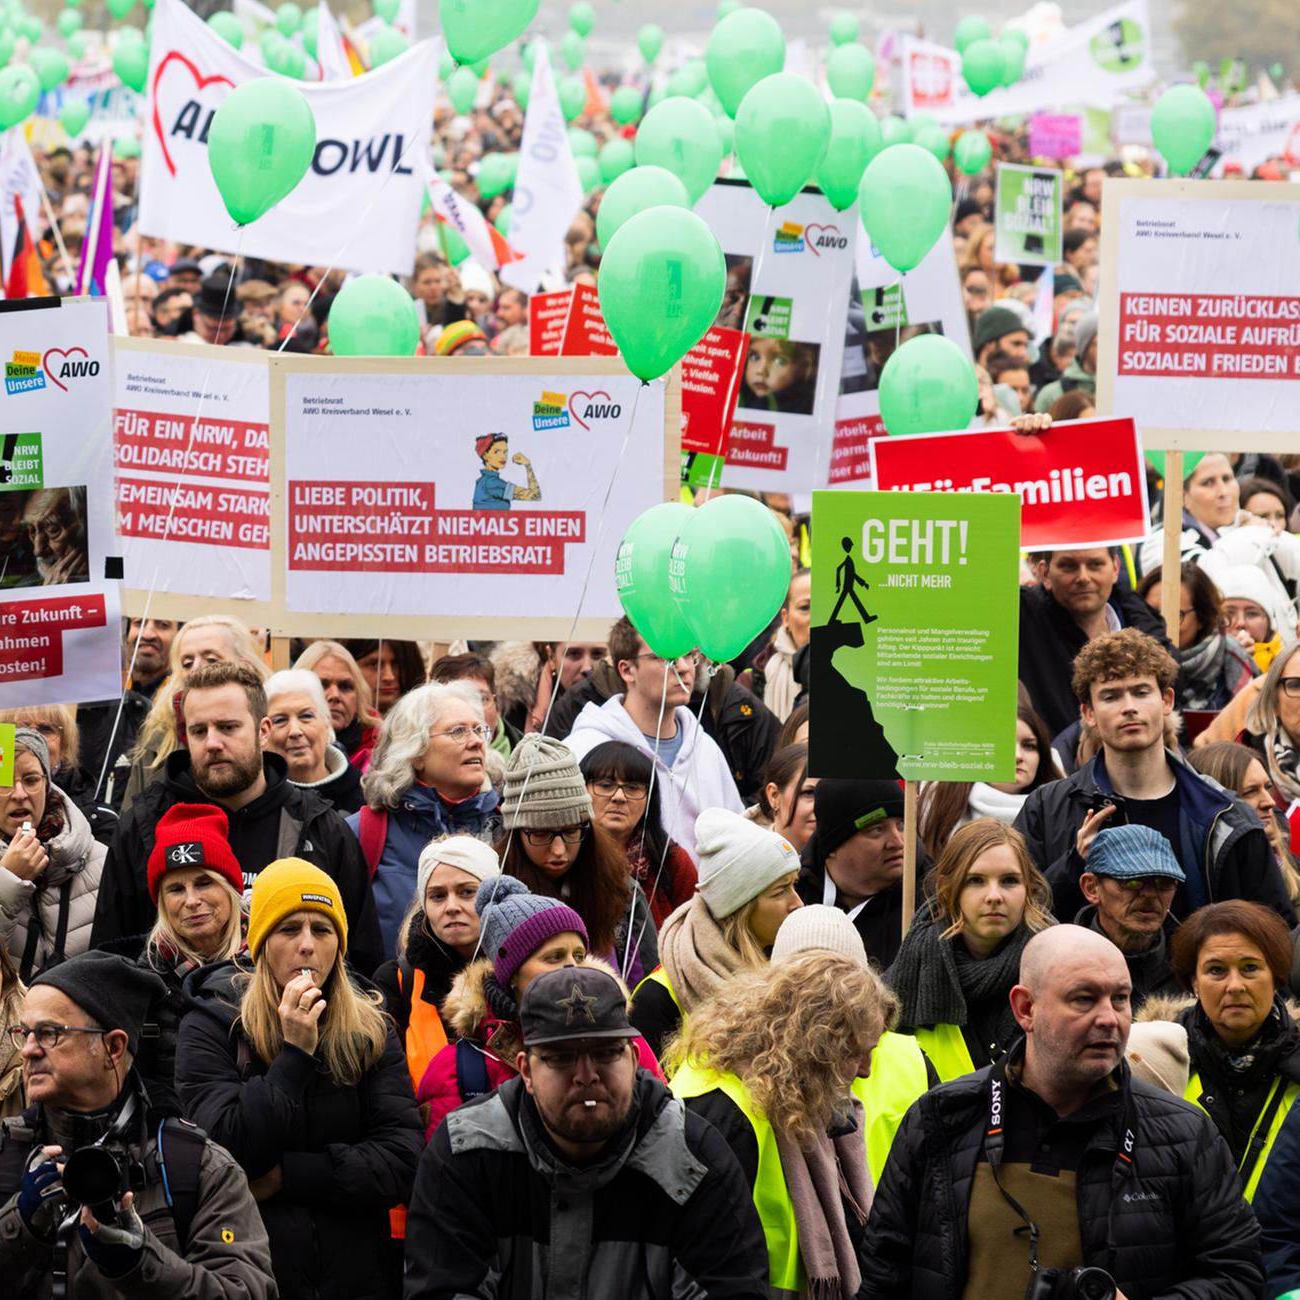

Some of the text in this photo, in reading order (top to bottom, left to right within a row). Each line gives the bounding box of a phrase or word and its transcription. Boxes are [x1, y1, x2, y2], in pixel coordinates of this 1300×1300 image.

[311, 132, 413, 177] OWL
[816, 235, 848, 249] AWO
[1125, 297, 1192, 316] KEINEN
[1125, 320, 1300, 346] FÜR SOZIALE AUFRÜ
[708, 346, 731, 358] spart,
[59, 360, 100, 378] AWO
[1122, 351, 1288, 374] SOZIALEN FRIEDEN
[7, 365, 35, 377] Deine
[689, 369, 719, 382] Vielfalt
[8, 377, 44, 392] Unsere
[127, 374, 166, 385] Betriebsrat
[144, 387, 190, 397] Kreisverband
[302, 396, 344, 405] Betriebsrat
[302, 407, 393, 416] AWO Kreisverband Wesel
[534, 405, 561, 414] Deine
[583, 404, 621, 419] AWO
[534, 415, 569, 429] Unsere
[114, 412, 237, 449] FÜR EIN NRW,
[729, 427, 767, 441] Arbeit
[14, 445, 39, 456] NRW
[730, 449, 782, 464] Zukunft!
[4, 460, 39, 471] BLEIBT
[226, 455, 270, 477] STEH
[5, 474, 40, 486] SOZIAL
[117, 483, 212, 510] EMEINSAM
[294, 487, 428, 510] LIEBE POLITIK,
[138, 512, 233, 540] MENSCHEN
[294, 512, 581, 537] UNTERSCHÄTZT NIEMALS EINEN
[862, 518, 969, 565] GEHT!
[293, 542, 553, 565] ANGEPISSTEN BETRIEBSRAT!
[878, 573, 952, 589] ...NICHT MEHR
[21, 604, 83, 624] Zukunft
[991, 1079, 1001, 1126] SONY
